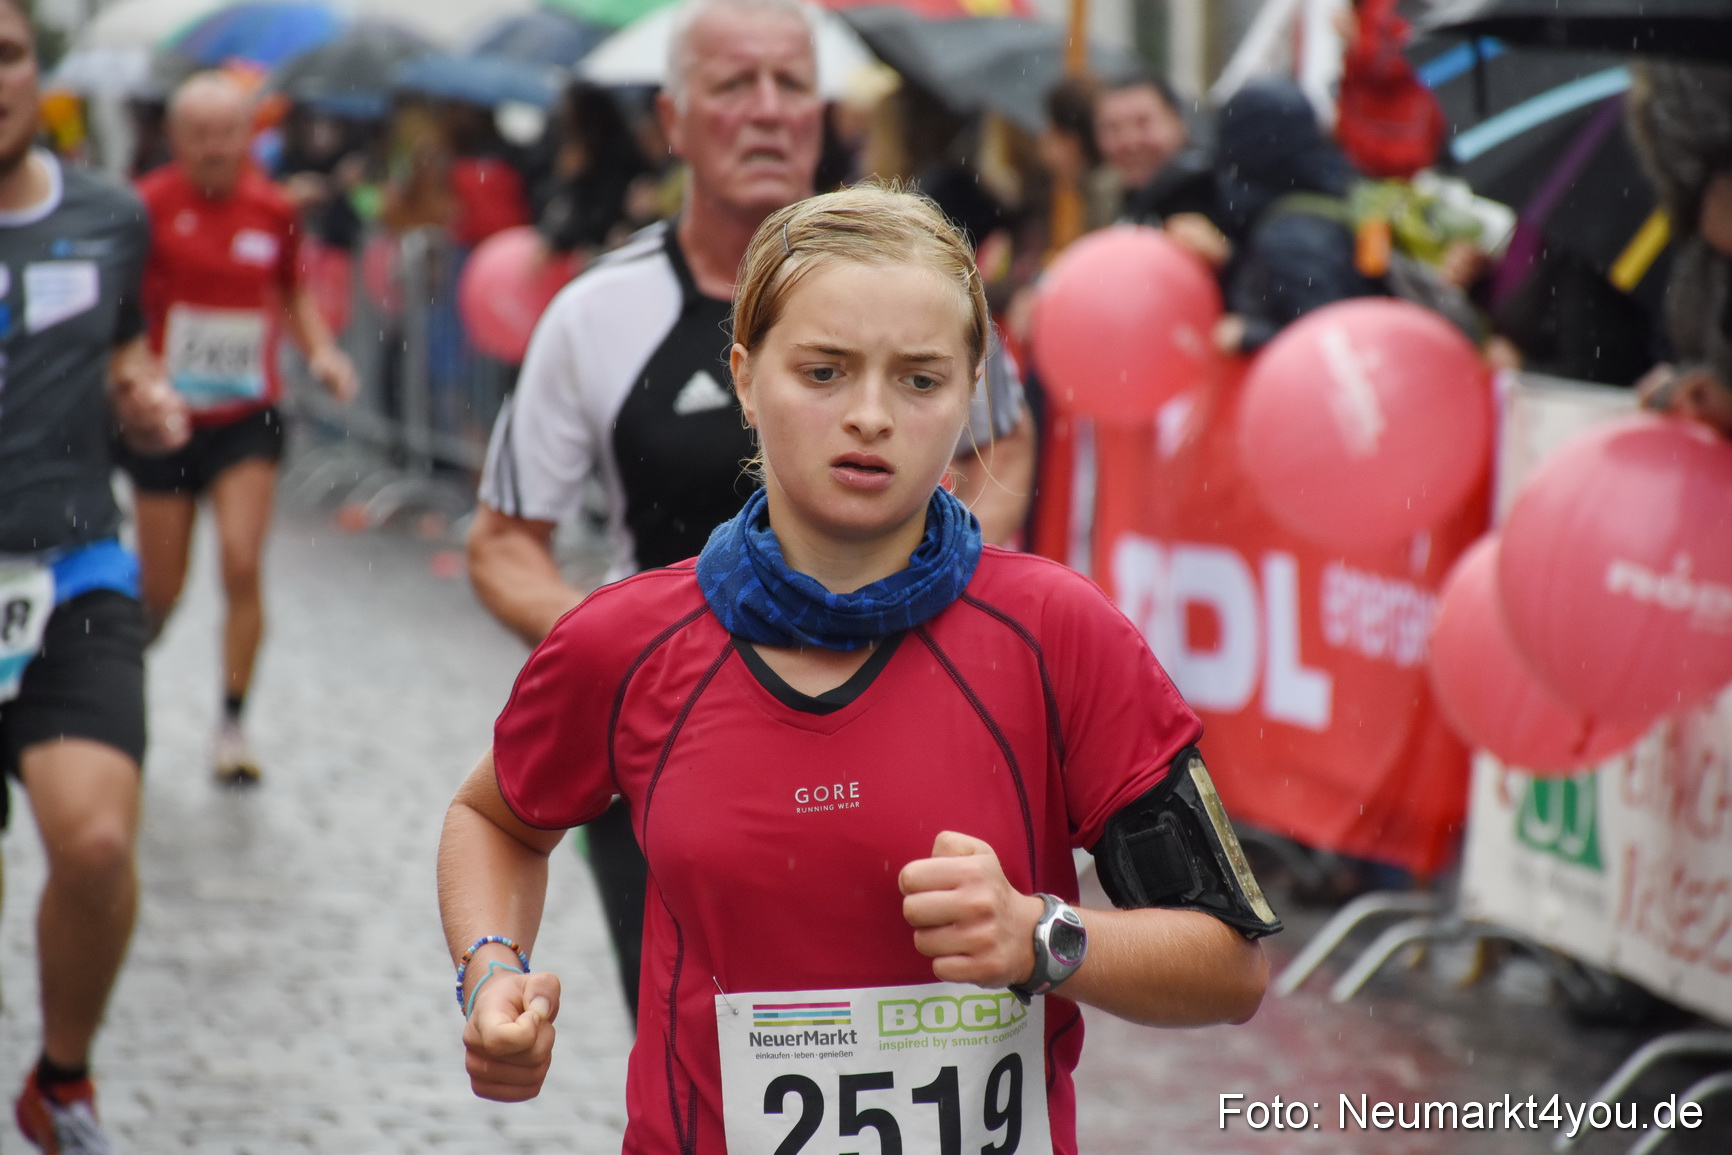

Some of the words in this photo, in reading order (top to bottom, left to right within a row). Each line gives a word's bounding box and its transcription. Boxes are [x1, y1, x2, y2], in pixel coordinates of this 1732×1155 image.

[794, 781, 860, 804] GORE
[796, 804, 835, 814] RUNNING
[837, 801, 860, 810] WEAR
[877, 991, 1028, 1037] BOCK
[749, 1028, 858, 1047] NeuerMarkt
[878, 1037, 929, 1051] inspired
[932, 1036, 948, 1049] by
[951, 1034, 989, 1046] smart
[991, 1020, 1028, 1043] concepts
[763, 1052, 1024, 1155] 2519
